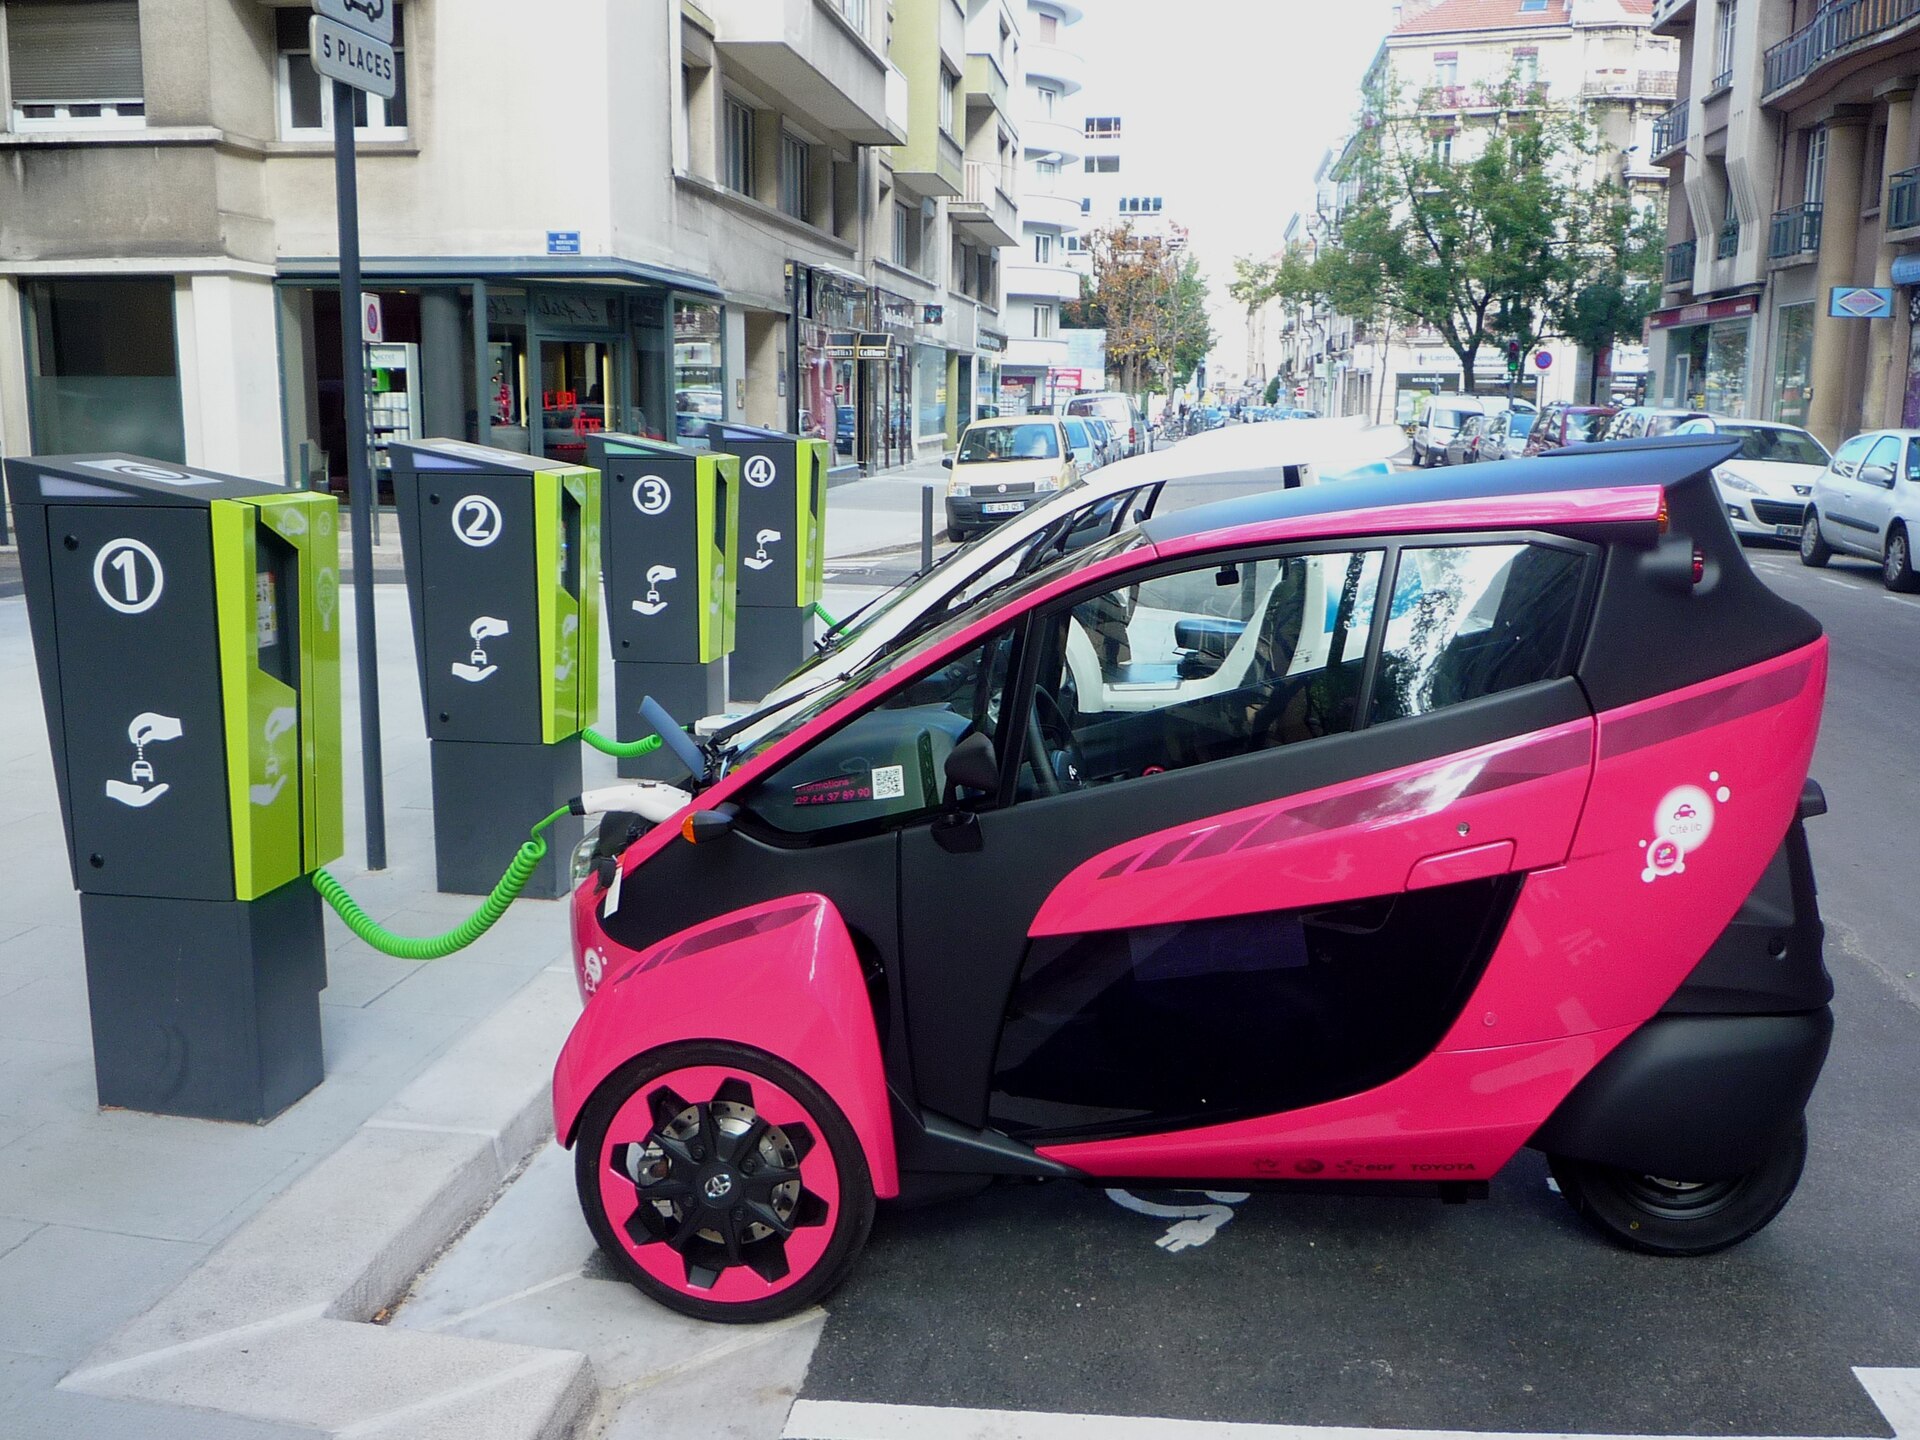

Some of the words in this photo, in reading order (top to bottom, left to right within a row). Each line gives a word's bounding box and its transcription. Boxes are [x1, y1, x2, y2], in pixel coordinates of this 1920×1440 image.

[323, 33, 332, 59] 5
[338, 39, 392, 80] PLACES
[750, 460, 768, 482] 4
[643, 482, 662, 509] 3
[465, 502, 490, 537] 2
[111, 550, 138, 601] 1
[811, 794, 824, 803] 64
[827, 792, 840, 801] 37
[842, 789, 855, 800] 89
[857, 787, 871, 797] 90
[1411, 1163, 1477, 1171] TOYOTA
